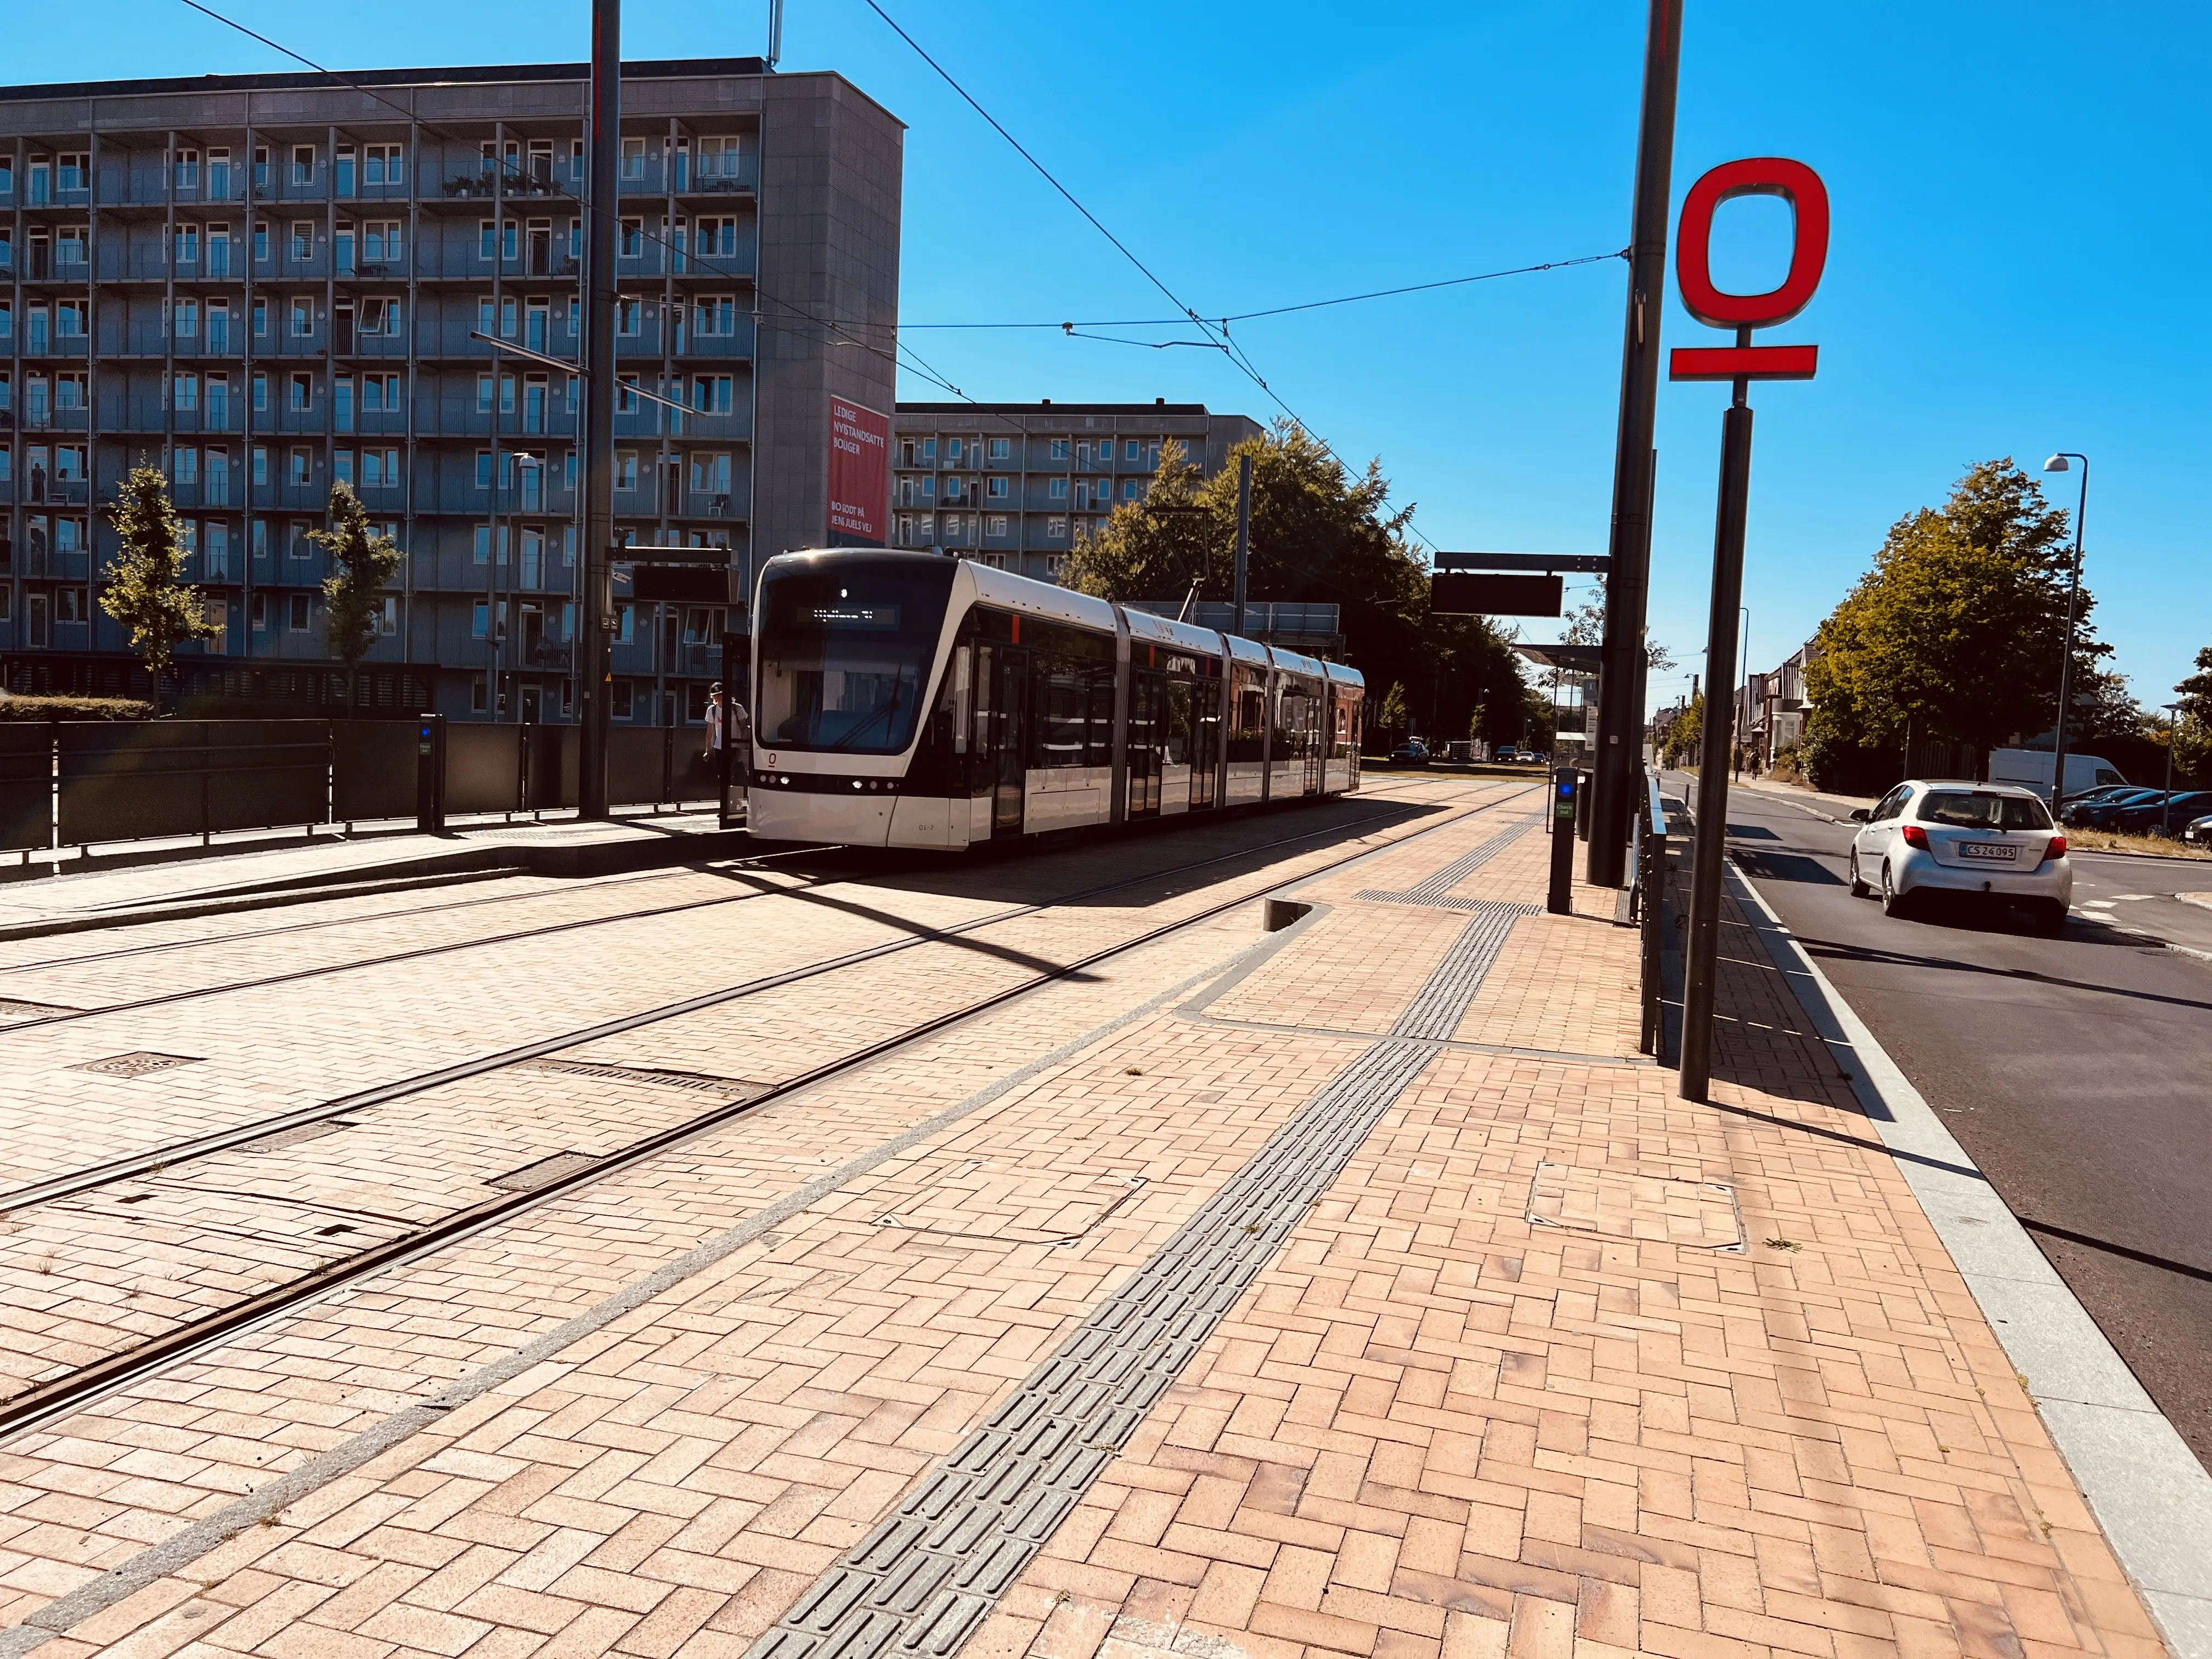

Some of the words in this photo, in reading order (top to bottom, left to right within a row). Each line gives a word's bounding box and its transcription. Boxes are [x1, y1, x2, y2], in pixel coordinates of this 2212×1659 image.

[834, 404, 856, 422] LEDIGE
[834, 421, 884, 448] NYISTANDSATTE
[834, 437, 860, 455] BOLIGER
[831, 500, 842, 512] BO
[842, 504, 857, 516] GODT
[857, 506, 865, 518] PÅ
[831, 515, 845, 527] JENS
[845, 518, 861, 531] JUELS
[862, 522, 872, 533] VEJ
